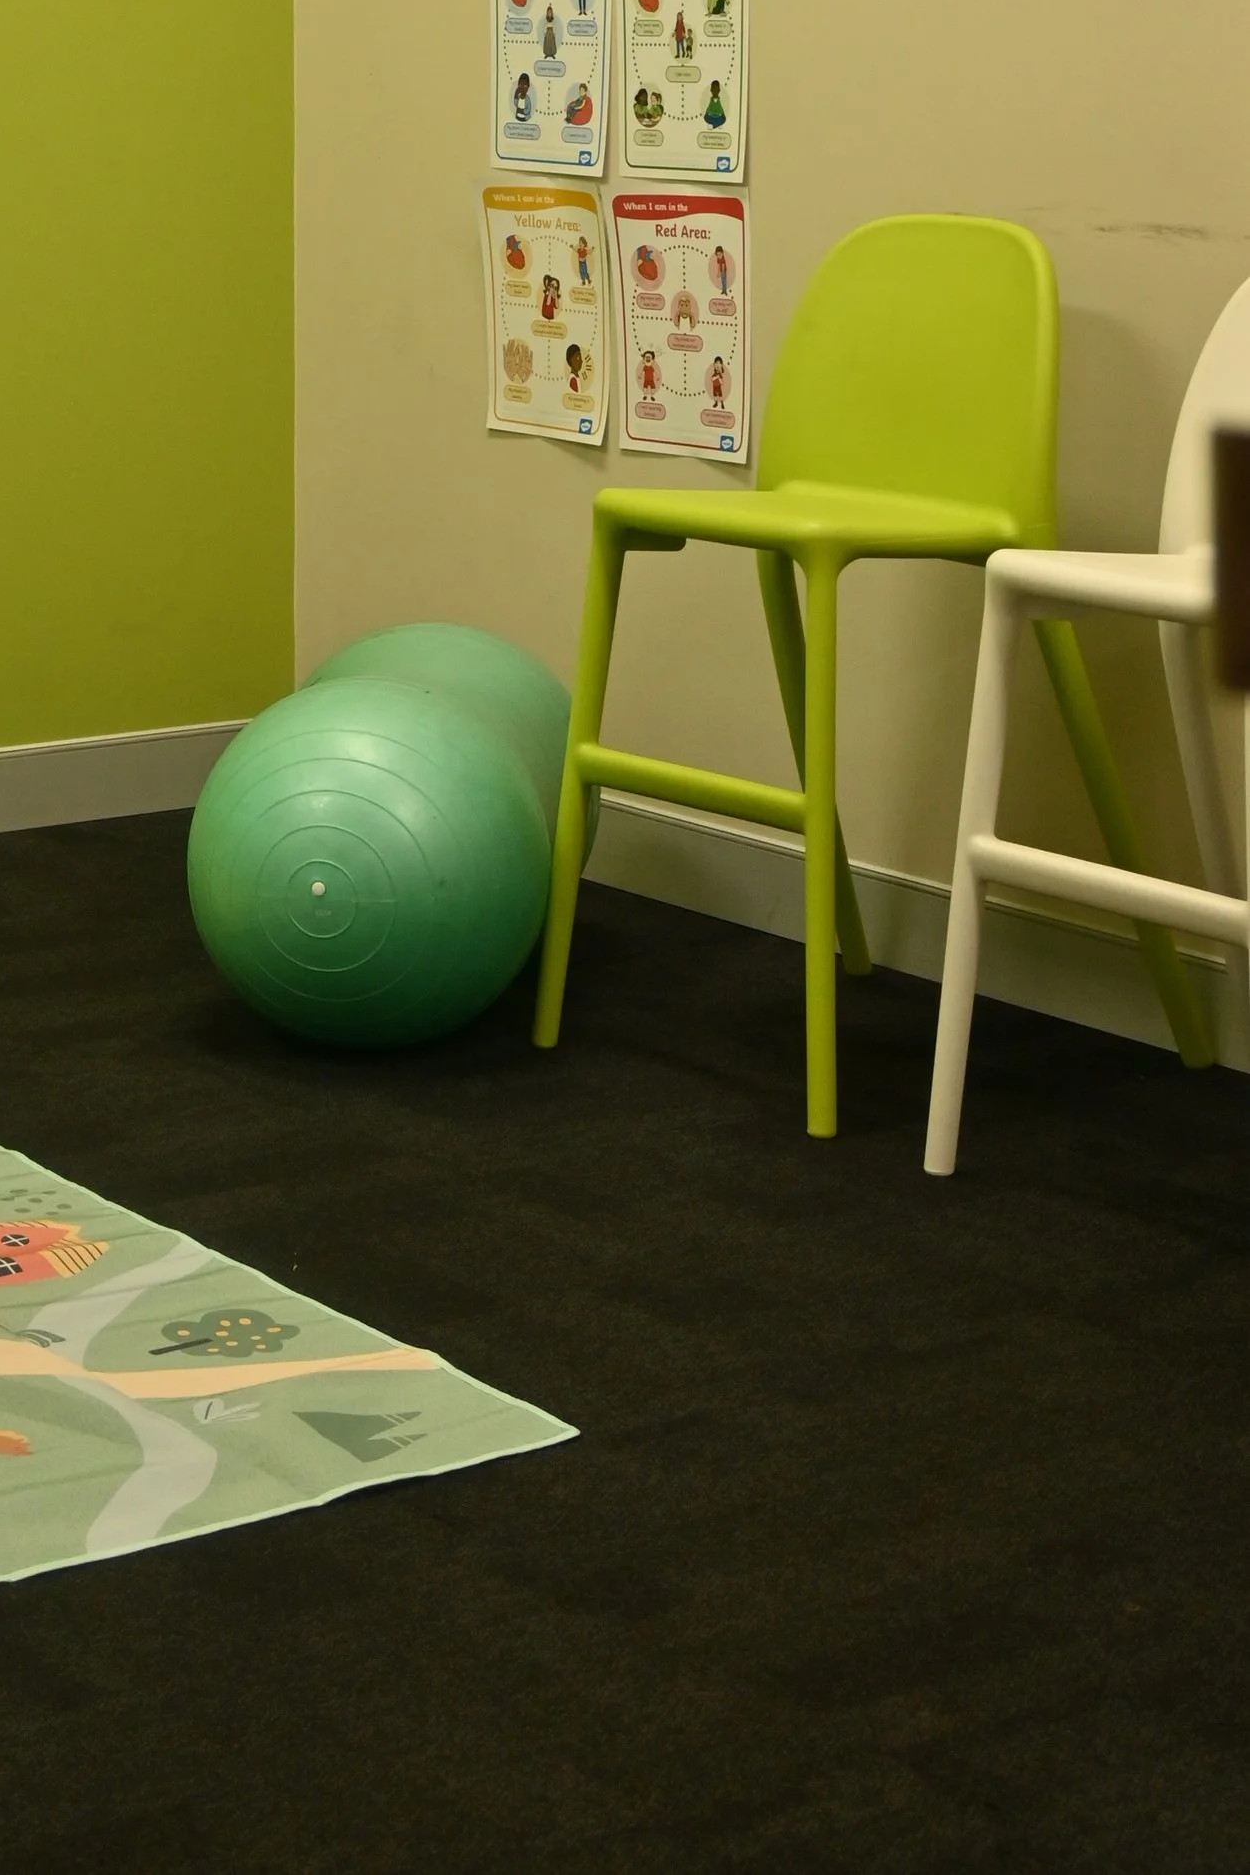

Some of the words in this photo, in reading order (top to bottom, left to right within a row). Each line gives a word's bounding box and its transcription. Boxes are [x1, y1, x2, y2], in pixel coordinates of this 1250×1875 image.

[492, 193, 516, 202] When
[522, 195, 534, 203] am
[535, 194, 542, 203] in
[543, 195, 555, 204] the
[623, 202, 647, 210] When
[654, 203, 667, 211] am
[668, 202, 676, 211] in
[677, 203, 688, 212] the
[514, 214, 552, 229] Yellow
[555, 217, 581, 232] Area:
[655, 223, 677, 237] Red
[680, 225, 711, 239] Area:
